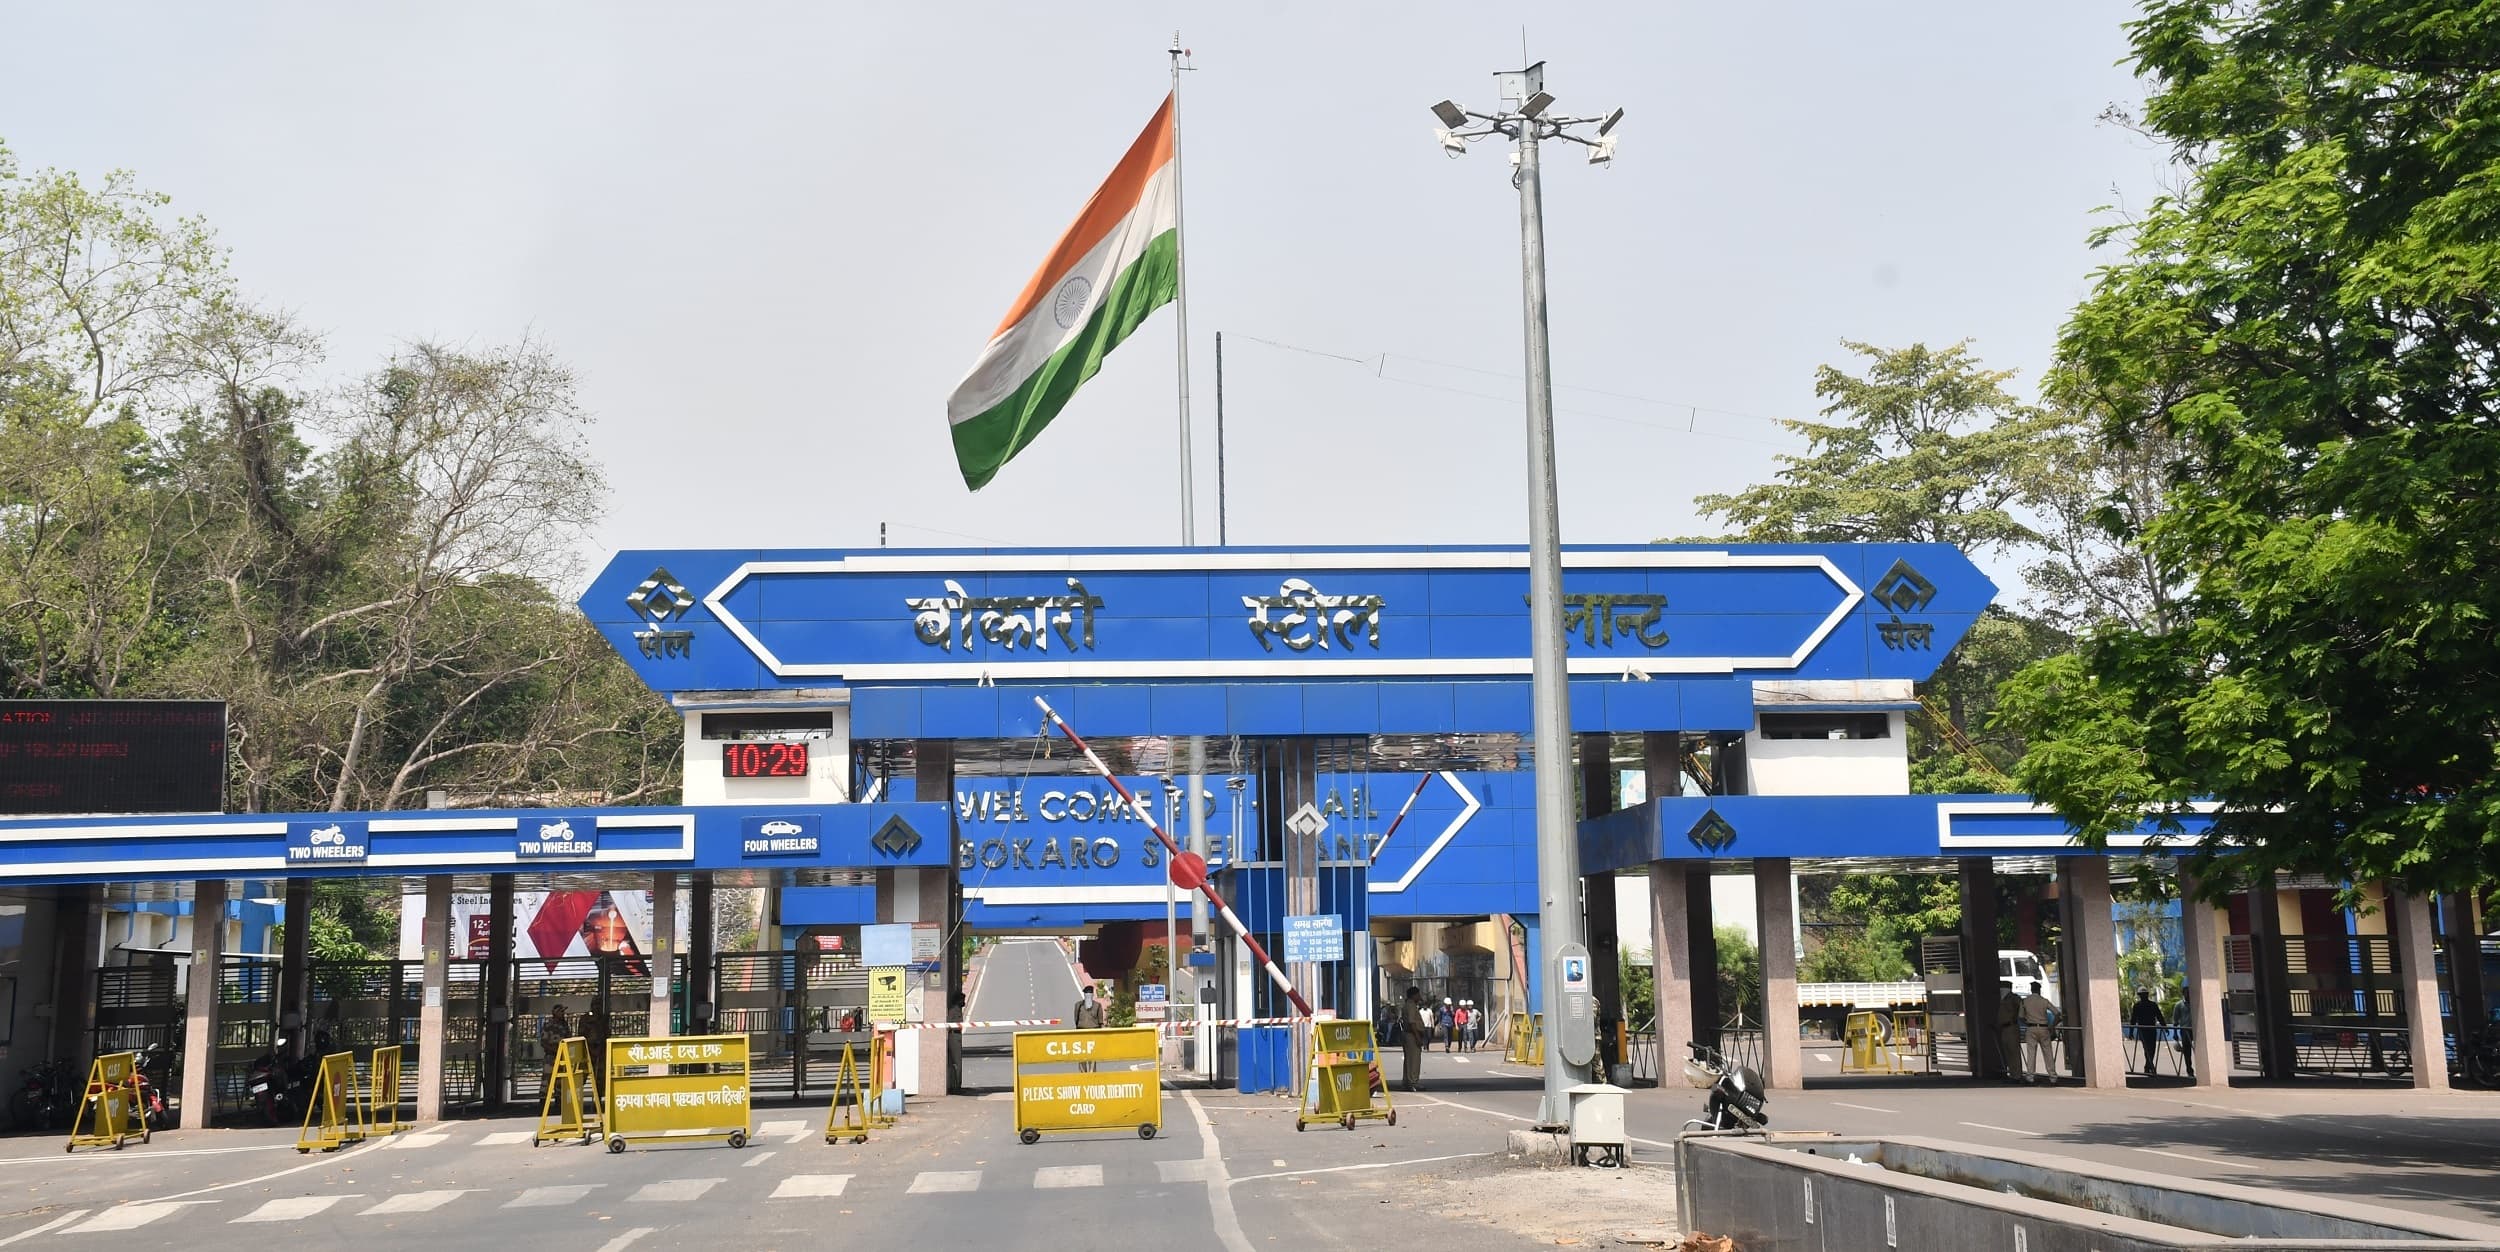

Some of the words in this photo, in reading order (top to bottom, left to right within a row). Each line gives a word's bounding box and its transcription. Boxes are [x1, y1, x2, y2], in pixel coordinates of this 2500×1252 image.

[905, 577, 1104, 654] बोकारो
[1241, 577, 1386, 652] स्टील
[727, 743, 807, 776] 10:29
[289, 847, 310, 859] TWO
[313, 845, 365, 858] WHEELERS
[519, 841, 541, 854] TWO
[543, 840, 593, 853] WHEELERS
[744, 839, 769, 852] FOUR
[770, 838, 818, 851] WHEELERS
[959, 837, 1120, 868] BOKARO
[1336, 1072, 1353, 1092] STOP
[1023, 1086, 1054, 1101] PLEASE
[1057, 1085, 1081, 1100] SHOW
[1084, 1085, 1106, 1100] YOUR
[1107, 1083, 1144, 1099] IDENTITY
[1069, 1103, 1096, 1115] CARD
